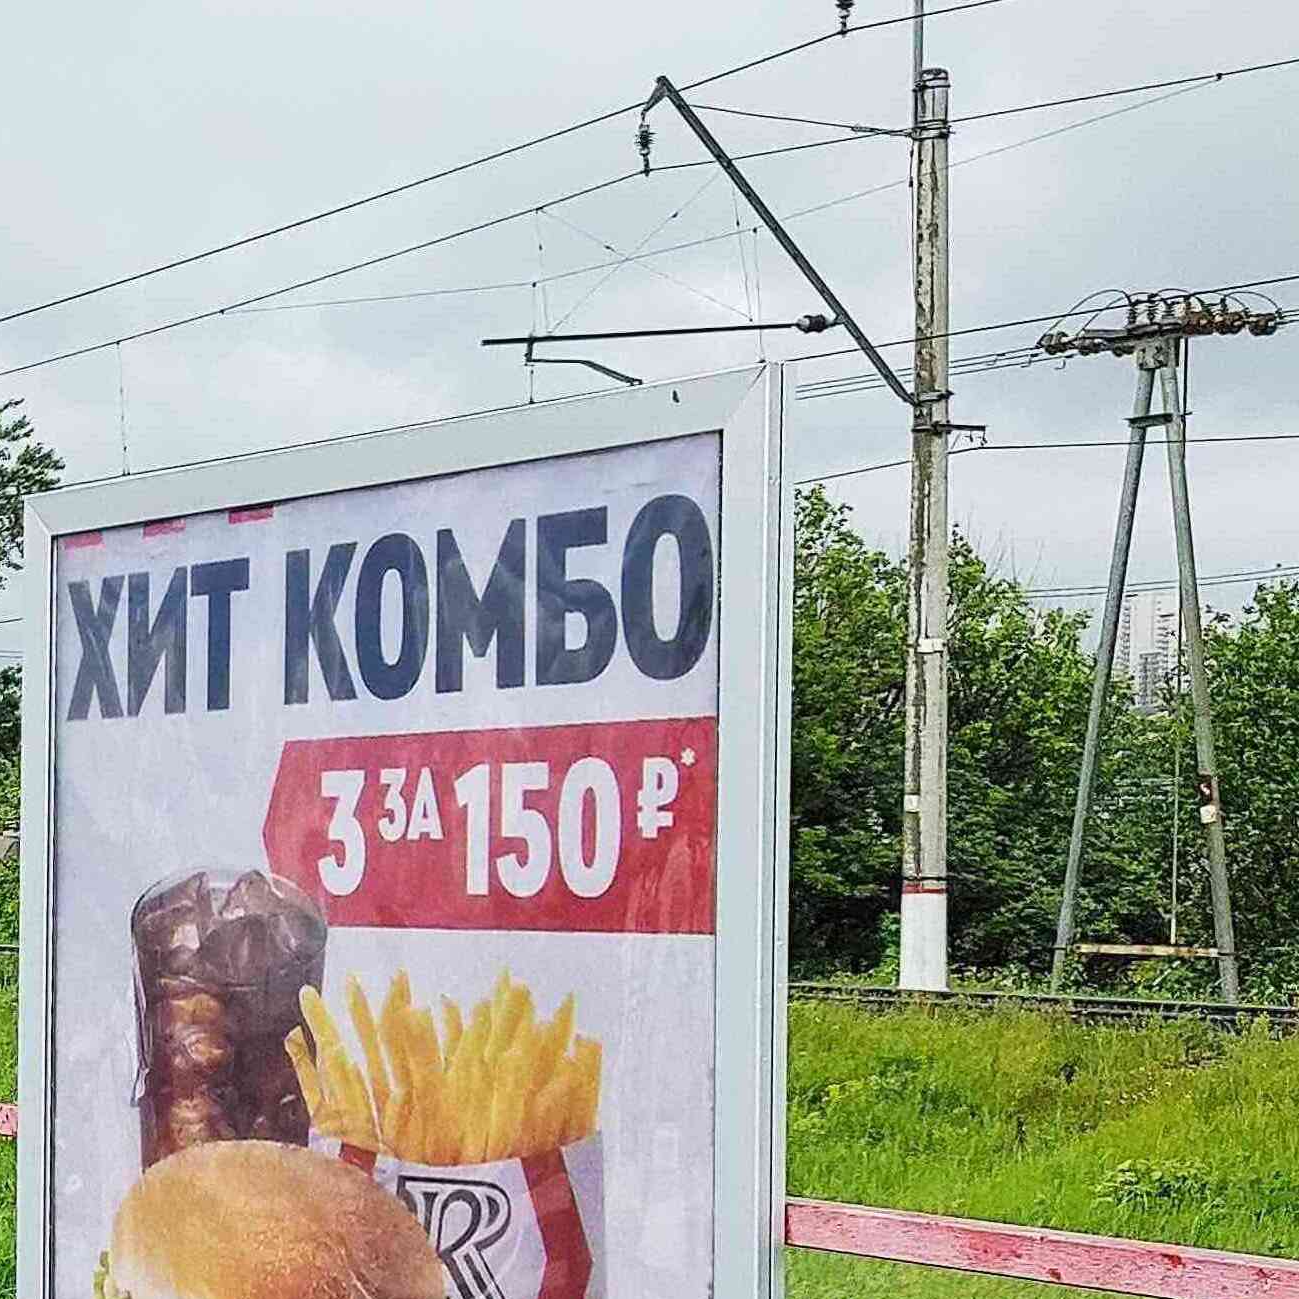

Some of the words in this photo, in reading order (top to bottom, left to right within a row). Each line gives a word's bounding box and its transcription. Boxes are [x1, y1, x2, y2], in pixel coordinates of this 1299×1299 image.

[66, 557, 250, 721] ХИТ
[284, 494, 714, 705] КОМБО
[316, 770, 366, 897] 3
[377, 768, 443, 842] ЗА
[454, 756, 622, 898] 150
